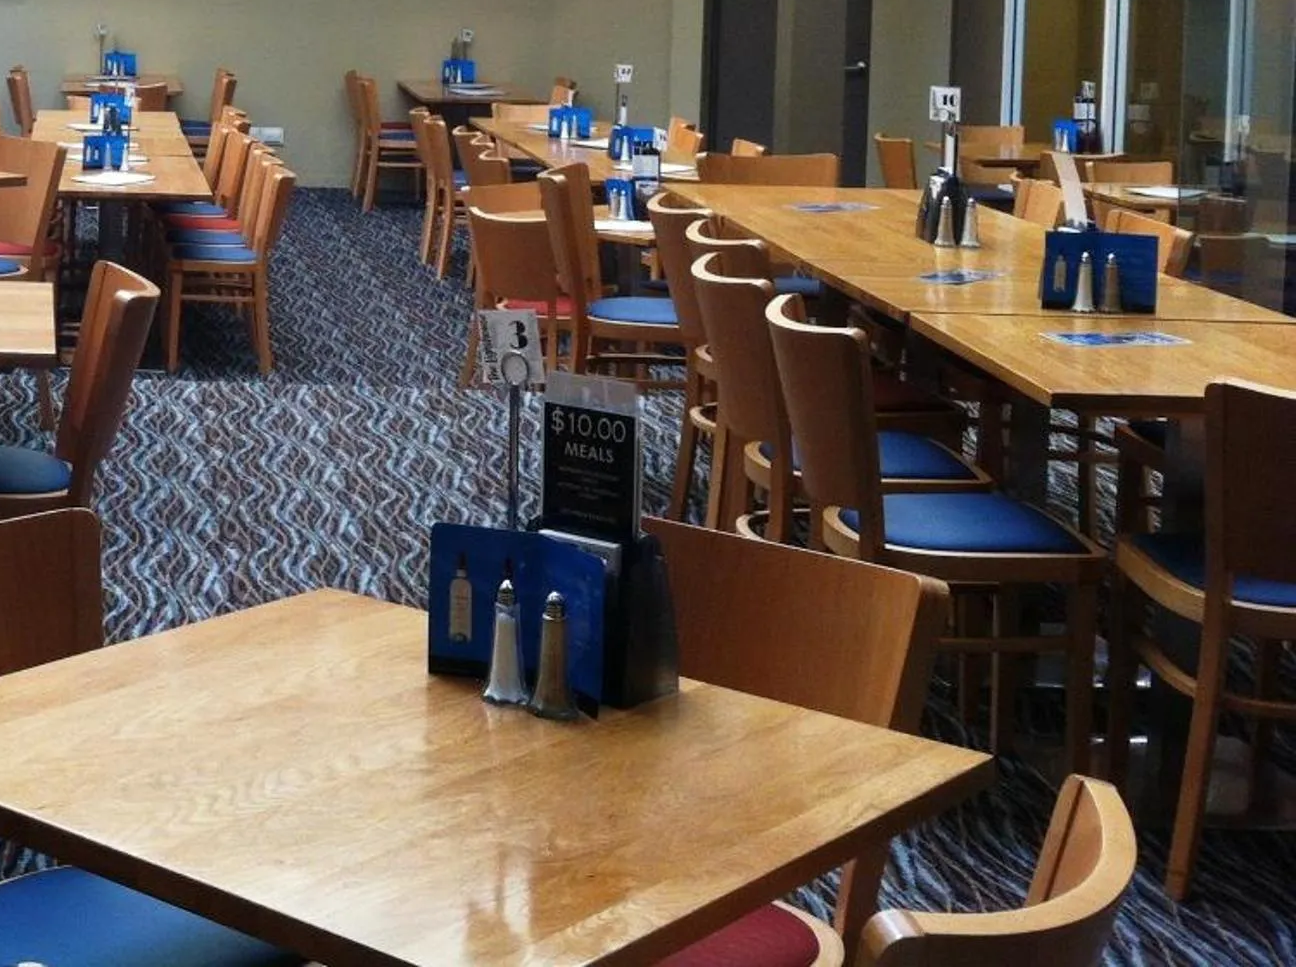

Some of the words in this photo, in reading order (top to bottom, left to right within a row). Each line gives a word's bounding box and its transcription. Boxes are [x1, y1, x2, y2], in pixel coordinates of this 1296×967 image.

[508, 320, 528, 349] 3
[551, 408, 626, 442] $10.00
[565, 442, 614, 463] MEALS
